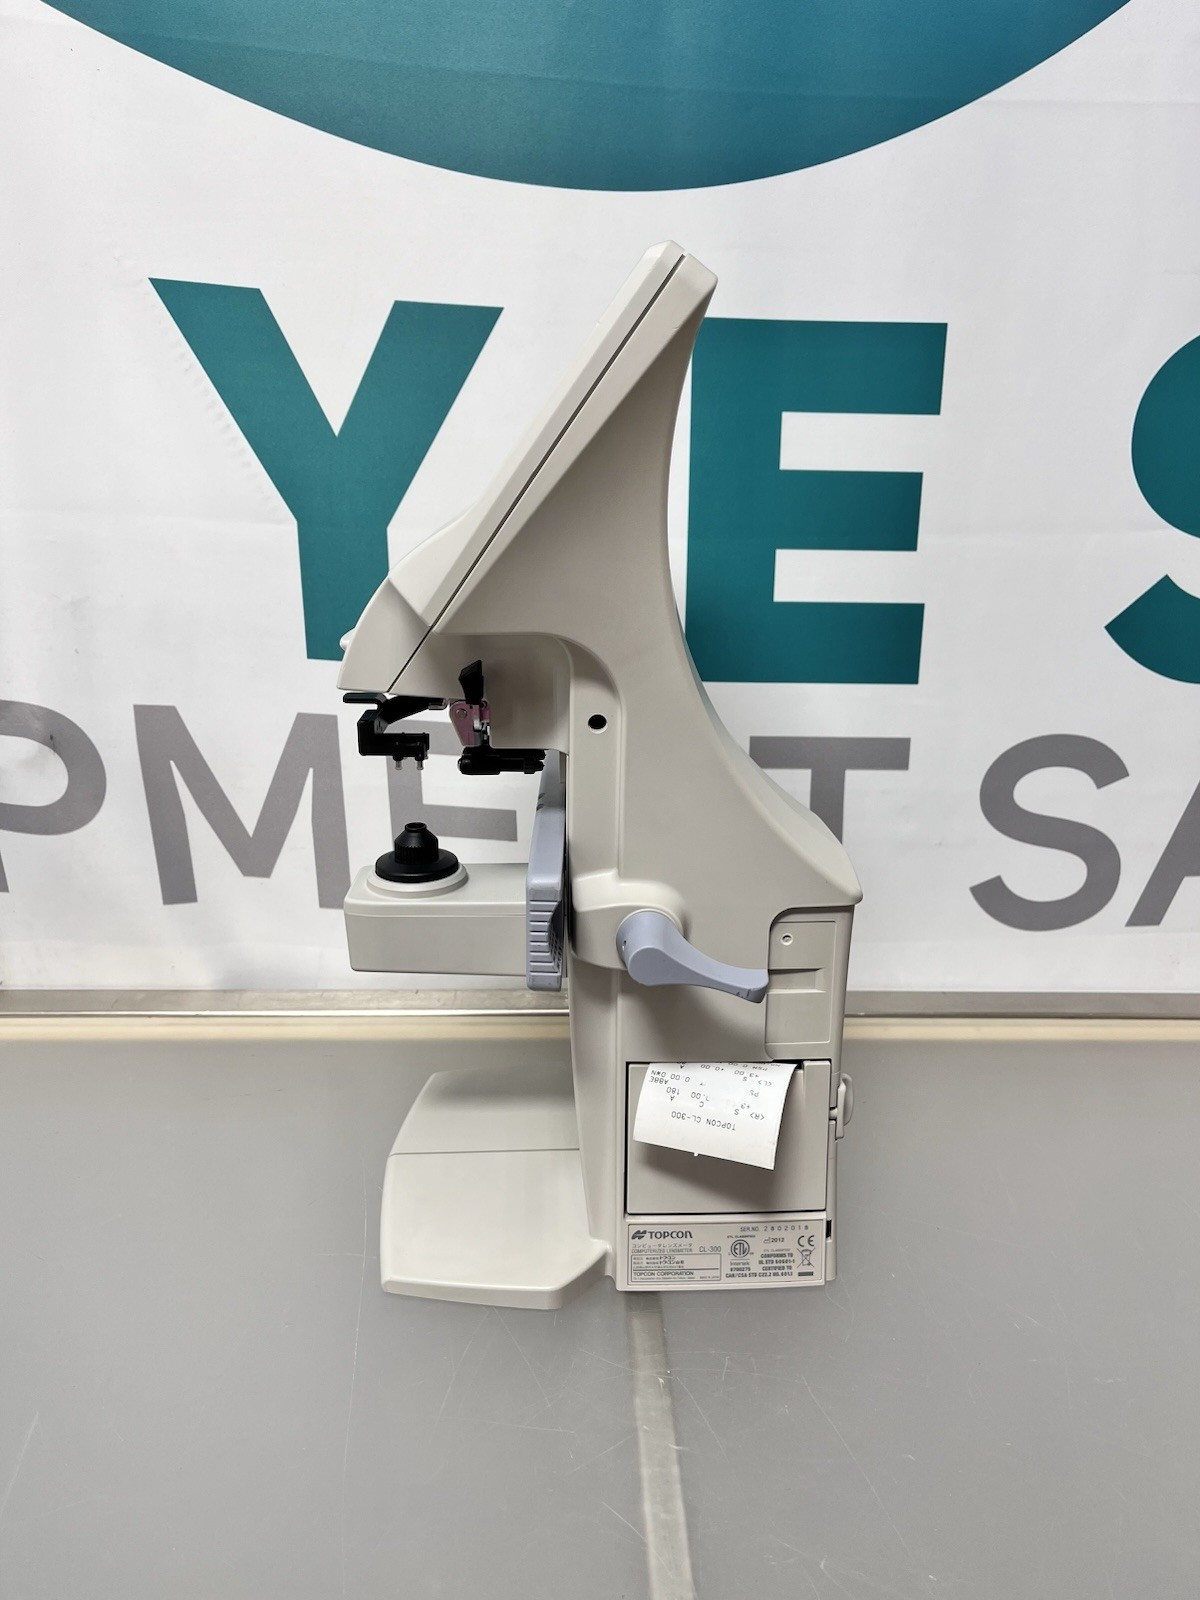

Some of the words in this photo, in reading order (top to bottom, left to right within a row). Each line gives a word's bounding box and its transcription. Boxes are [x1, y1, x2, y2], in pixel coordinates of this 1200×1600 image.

[666, 1086, 680, 1096] 180
[671, 1111, 702, 1123] CL-300
[734, 1108, 740, 1116] S
[705, 1118, 736, 1131] TOPCON
[647, 1230, 693, 1239] TOPCON
[797, 1234, 815, 1247] CE
[698, 1245, 722, 1253] CL-300
